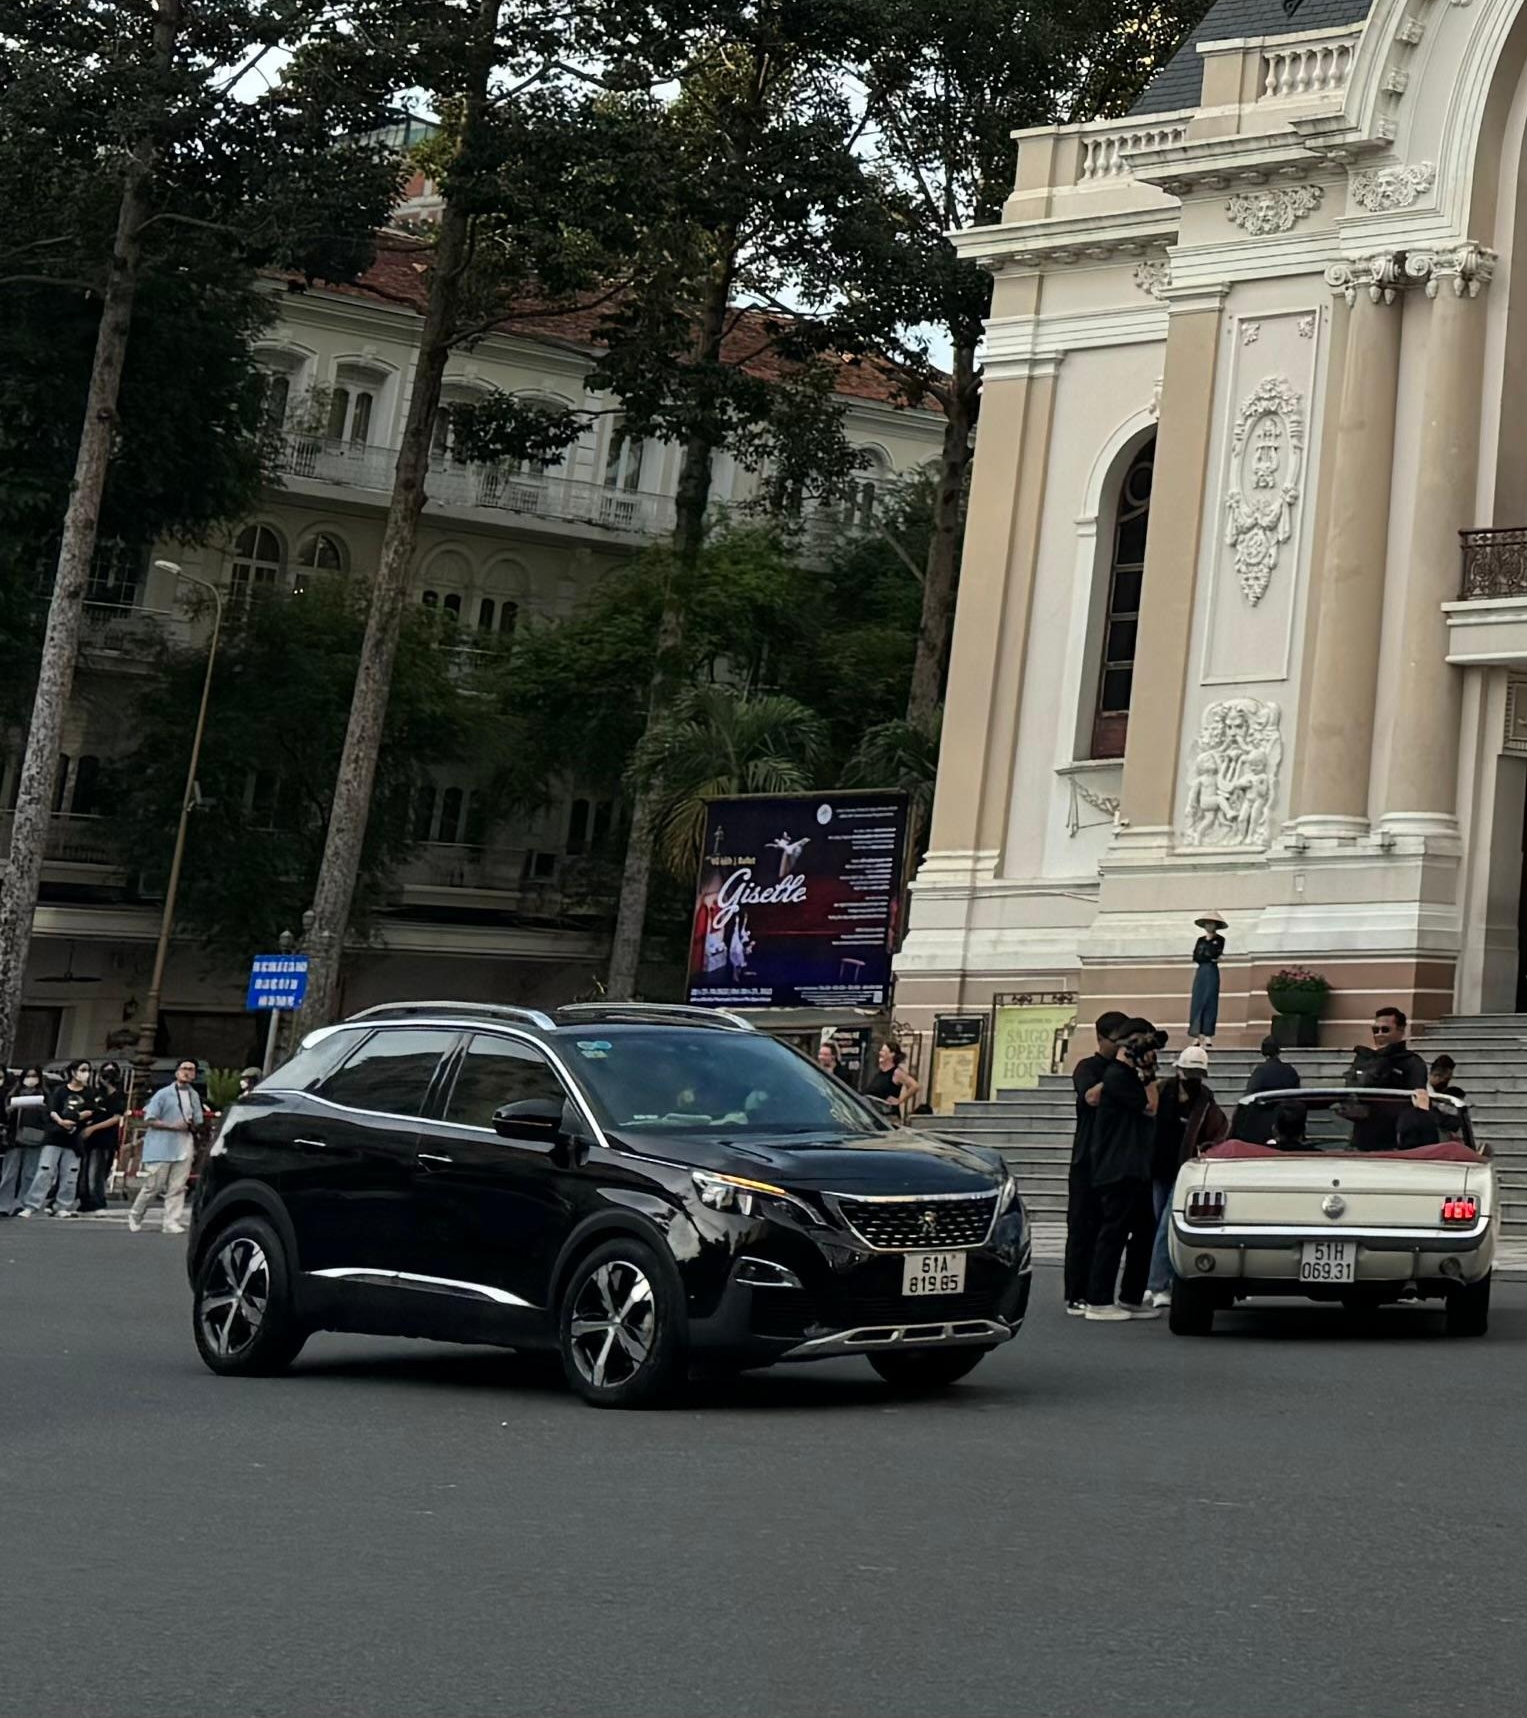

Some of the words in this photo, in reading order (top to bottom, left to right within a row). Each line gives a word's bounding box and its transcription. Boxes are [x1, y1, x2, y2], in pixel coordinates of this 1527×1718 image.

[712, 868, 807, 930] Giselle
[1007, 1028, 1053, 1043] SAIGO
[1004, 1044, 1051, 1060] OPER
[1003, 1062, 1049, 1079] HOUS
[1315, 1243, 1344, 1261] 51H
[1302, 1262, 1351, 1280] 069.31
